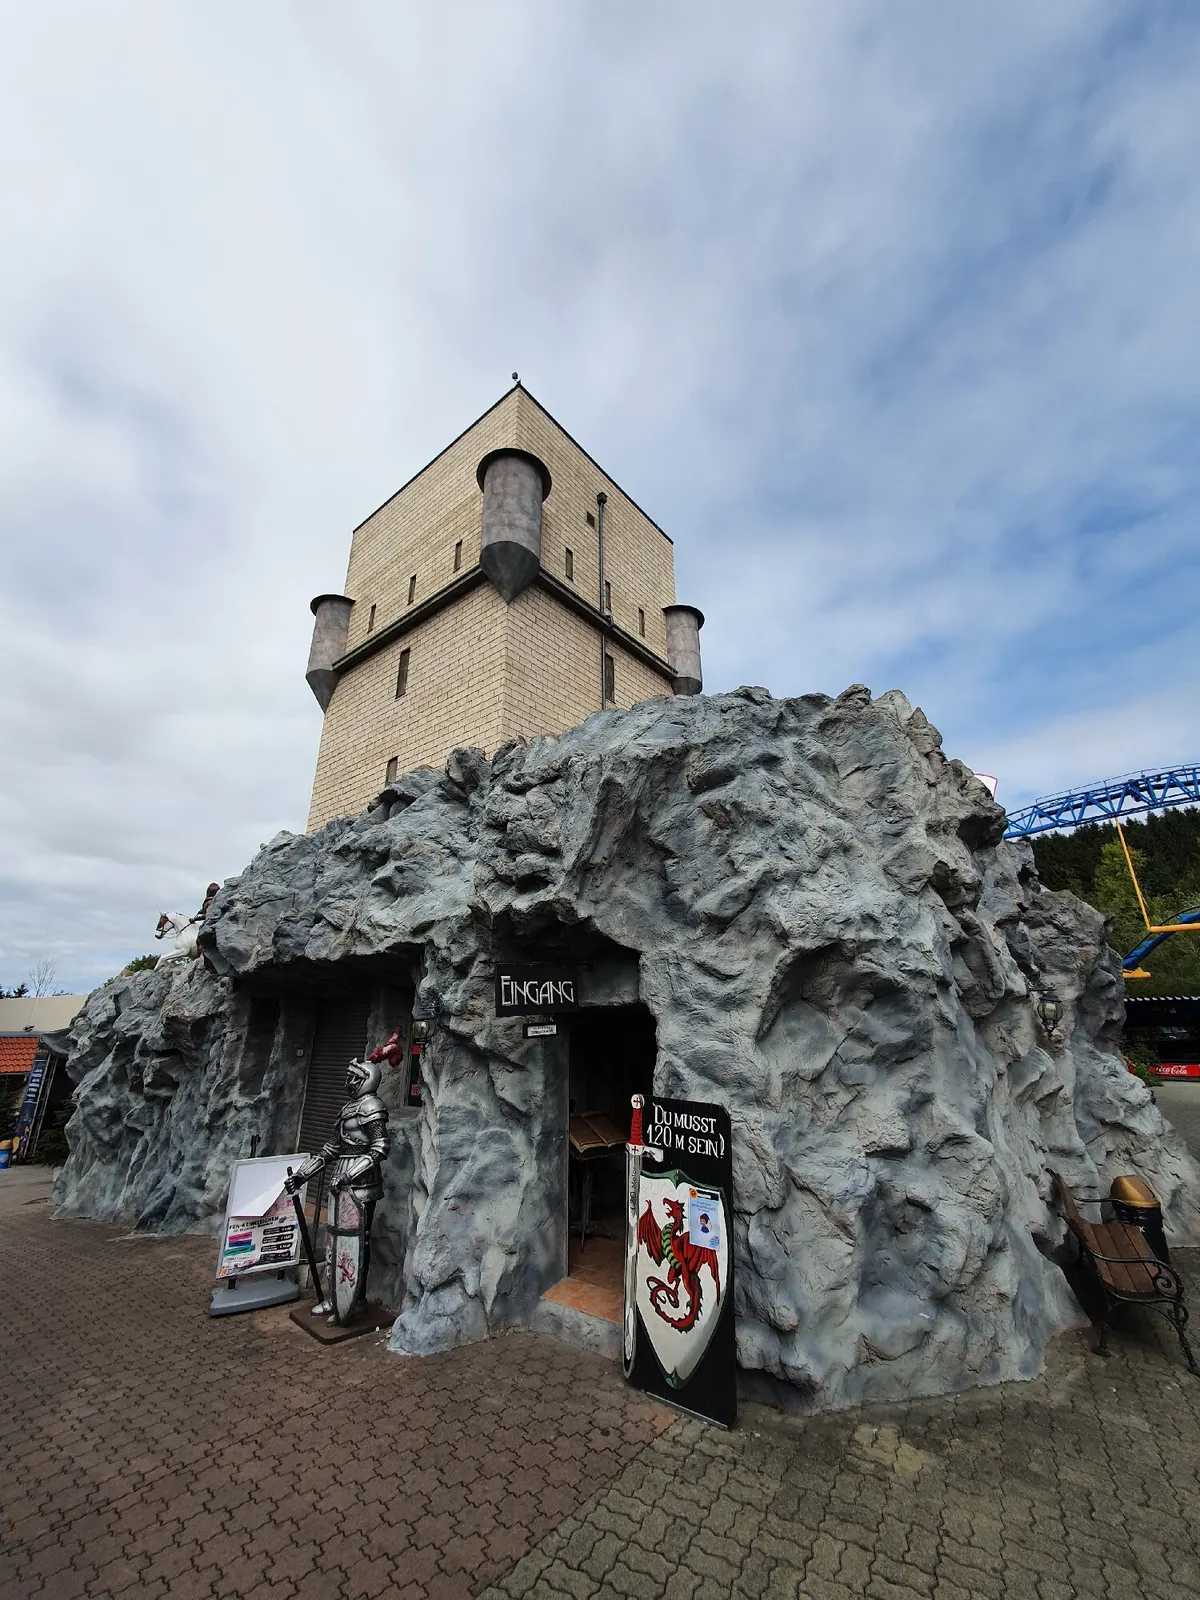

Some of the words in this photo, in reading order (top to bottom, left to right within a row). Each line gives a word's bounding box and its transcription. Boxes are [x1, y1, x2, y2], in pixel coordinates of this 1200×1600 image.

[500, 975, 574, 1006] EINGANG
[674, 1112, 717, 1134] MUSST
[675, 1134, 685, 1150] M
